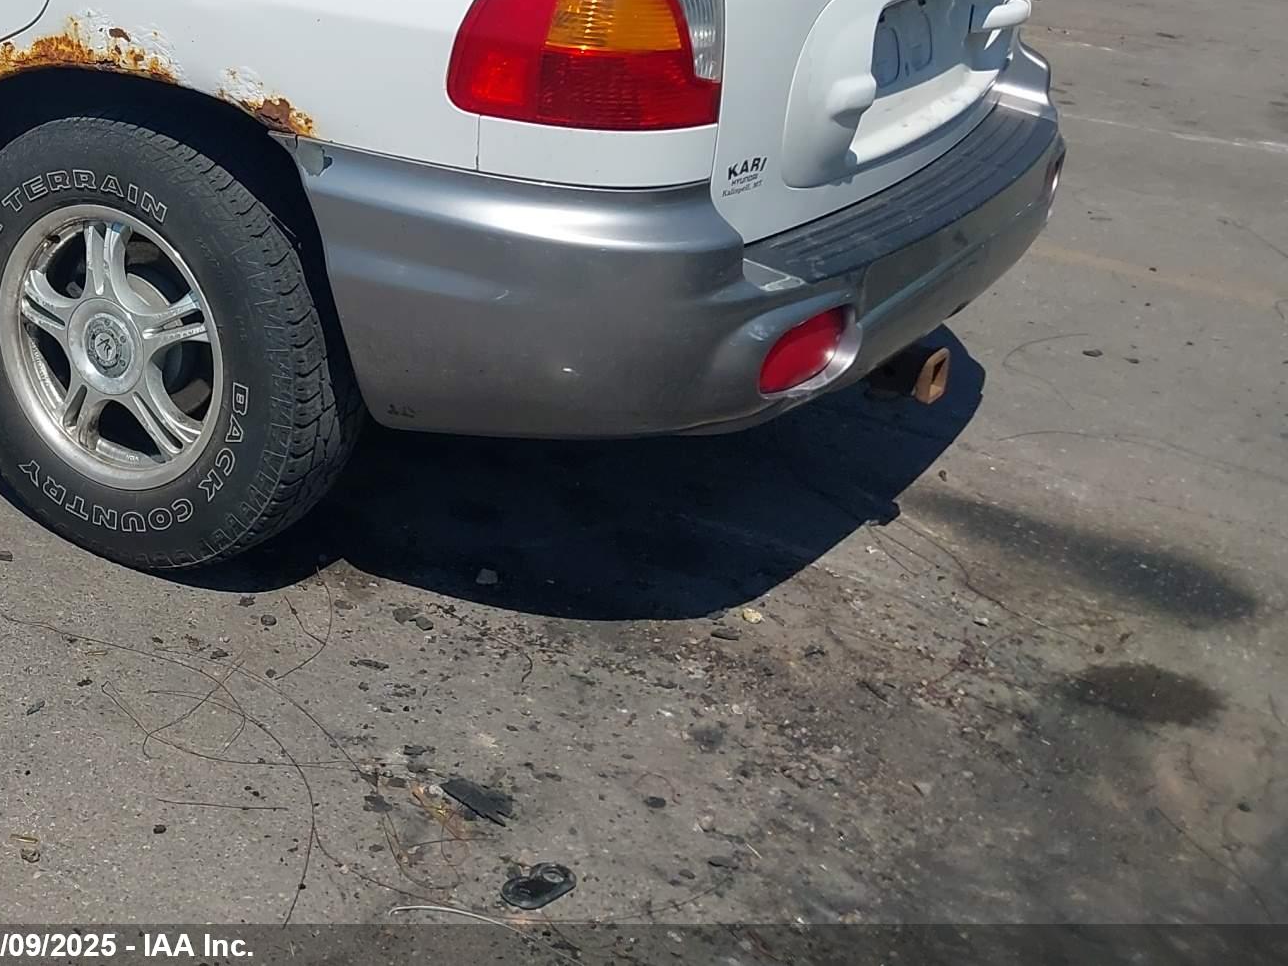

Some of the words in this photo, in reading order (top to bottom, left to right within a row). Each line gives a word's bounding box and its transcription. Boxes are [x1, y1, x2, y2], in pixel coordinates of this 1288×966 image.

[1, 169, 168, 224] TERRAIN
[727, 157, 767, 181] KARI
[198, 382, 249, 503] BACK
[18, 460, 194, 532] COUNTRY
